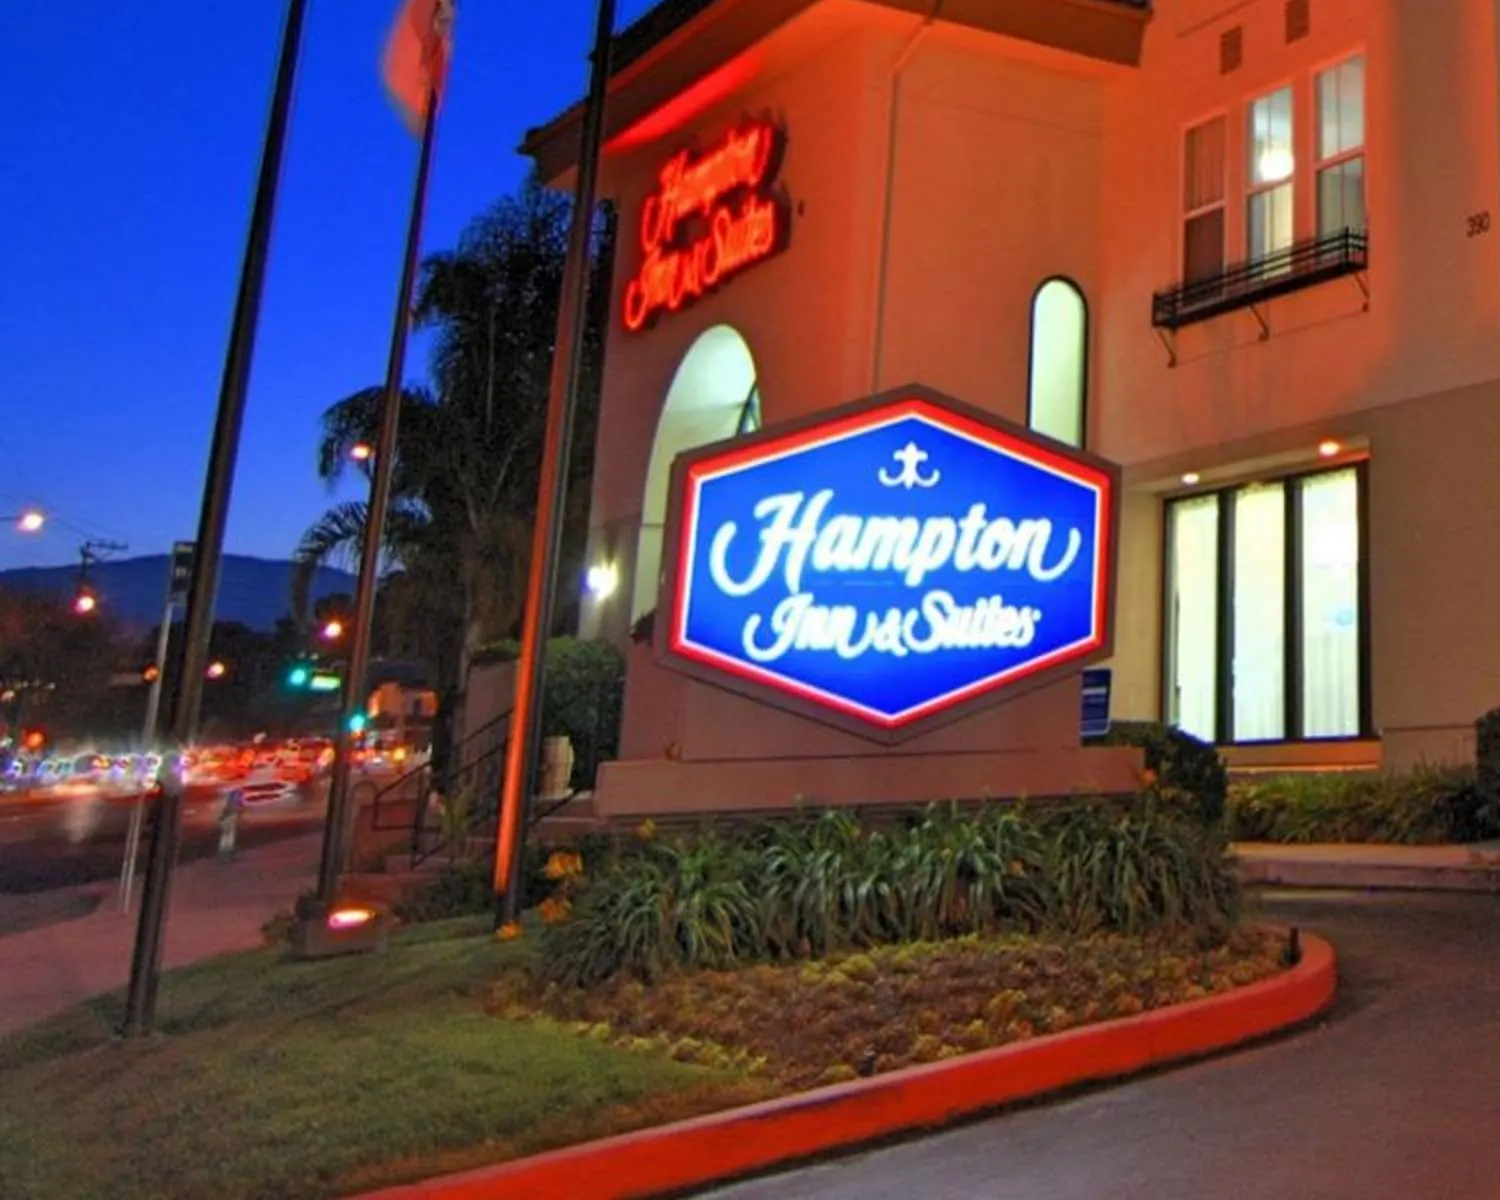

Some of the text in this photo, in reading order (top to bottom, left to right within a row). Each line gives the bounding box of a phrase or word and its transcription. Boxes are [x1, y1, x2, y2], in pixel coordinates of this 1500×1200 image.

[709, 489, 1082, 597] Hampton
[742, 589, 1036, 662] Inn & Suites
